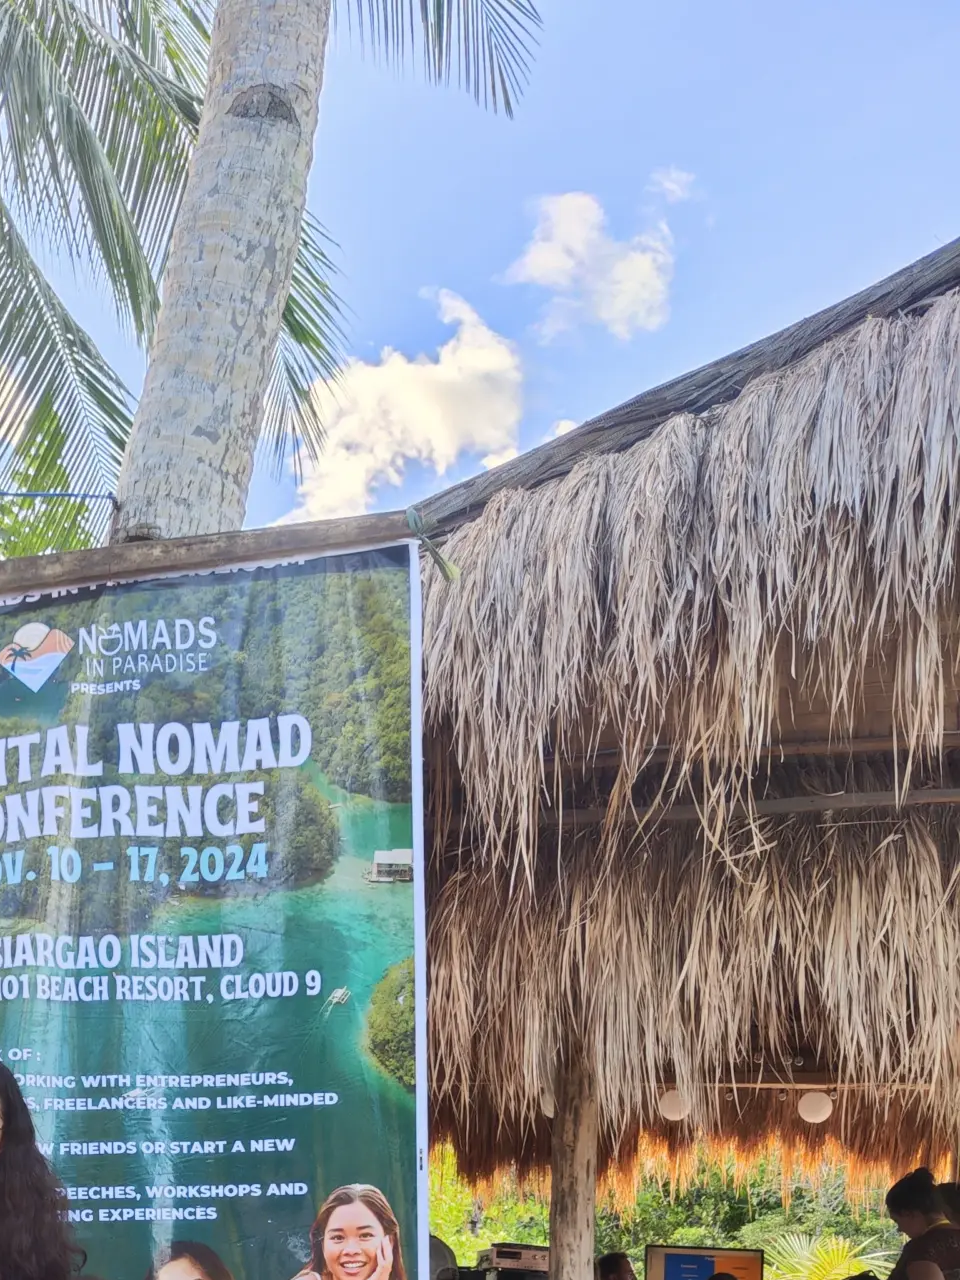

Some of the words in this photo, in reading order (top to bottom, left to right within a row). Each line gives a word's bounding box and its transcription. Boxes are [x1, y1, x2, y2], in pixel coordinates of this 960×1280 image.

[78, 617, 217, 656] NOMADS
[86, 659, 104, 676] IN
[113, 652, 208, 675] PARADISE
[71, 680, 140, 694] PRESENTS
[117, 713, 312, 775] NOMAD
[47, 845, 82, 883] 10
[127, 846, 170, 887] 17,
[180, 843, 268, 882] 2024
[131, 933, 244, 968] ISLAND
[37, 975, 109, 1001] BEACH
[115, 974, 214, 1005] RESORT,
[221, 970, 299, 998] CLOUD
[305, 970, 321, 996] 9
[13, 1074, 76, 1088] ORKING
[81, 1075, 131, 1088] WITH
[136, 1072, 294, 1088] ENTREPRENEURS,
[44, 1096, 167, 1111] FREELANCERS
[172, 1097, 211, 1110] AND
[216, 1093, 339, 1109] LIKE-MINDED
[60, 1141, 137, 1156] FRIENDS
[141, 1141, 166, 1155] OR
[169, 1140, 227, 1154] START
[231, 1140, 246, 1153] A
[251, 1138, 296, 1152] NEW
[145, 1184, 262, 1199] WORKSHOPS
[266, 1183, 308, 1196] AND
[98, 1206, 217, 1222] EXPERIENCES
